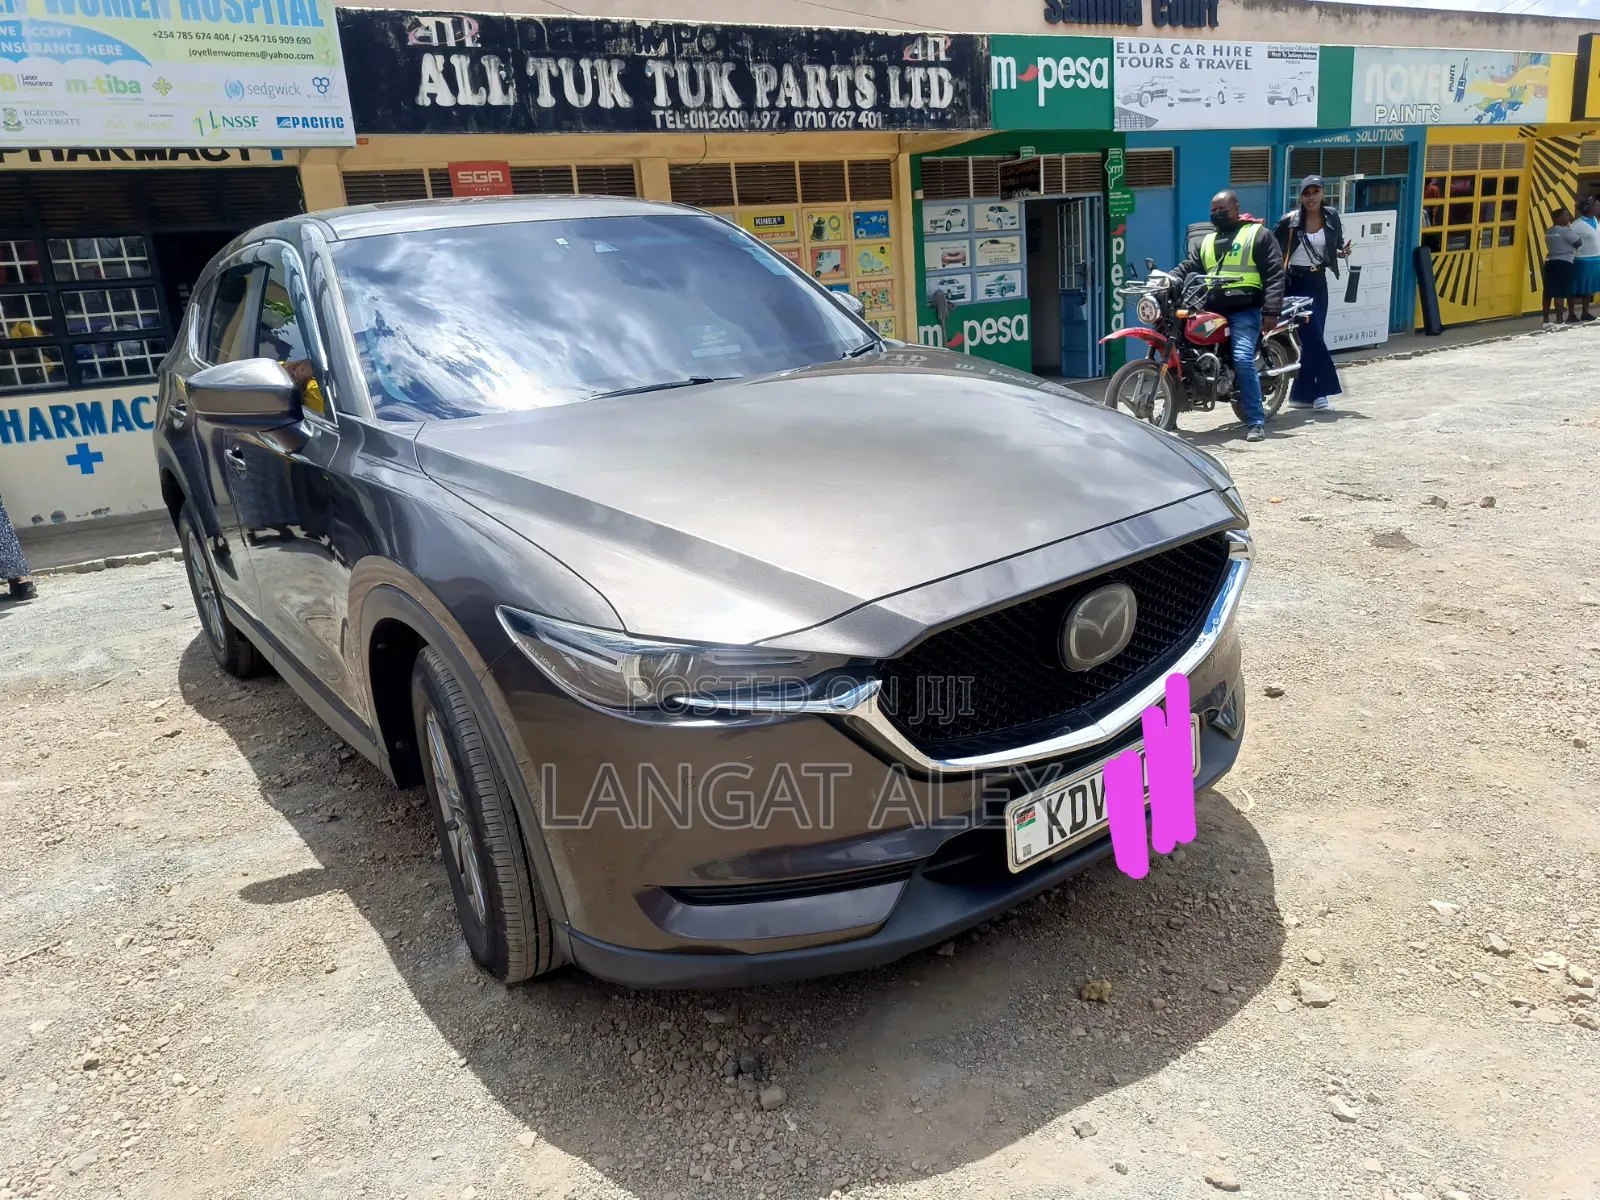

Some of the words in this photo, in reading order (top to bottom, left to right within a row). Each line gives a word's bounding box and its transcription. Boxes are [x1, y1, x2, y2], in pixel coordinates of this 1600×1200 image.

[22, 26, 72, 38] ACCEPT
[152, 31, 174, 39] +254
[176, 32, 193, 40] 785
[261, 36, 278, 44] 716
[278, 36, 294, 44] 909
[86, 45, 123, 56] HERE
[188, 48, 314, 60] joyellenwomens@yahoo.com
[1116, 42, 1164, 54] ELDA
[1170, 44, 1206, 56] CAR
[1212, 45, 1252, 57] HIRE
[1116, 56, 1174, 68] TOURS
[1180, 58, 1190, 68] &
[1195, 58, 1252, 70] TRAVEL
[415, 52, 518, 107] ALL
[526, 56, 634, 110] TUK
[646, 59, 742, 110] TUK
[751, 62, 877, 110] PARTS
[886, 64, 954, 109] LTD
[247, 82, 300, 99] sedgwick
[794, 111, 827, 129] 0710
[829, 111, 856, 129] 767
[857, 111, 883, 129] 401
[1374, 103, 1441, 123] PAINTS
[25, 118, 80, 126] UNIVERSITY
[222, 116, 260, 128] NSSF
[292, 116, 344, 128] PACIFIC
[1356, 128, 1404, 142] SOLUTIONS
[458, 170, 504, 184] SGA
[1334, 334, 1353, 344] SWAP
[1361, 330, 1378, 338] RIDE
